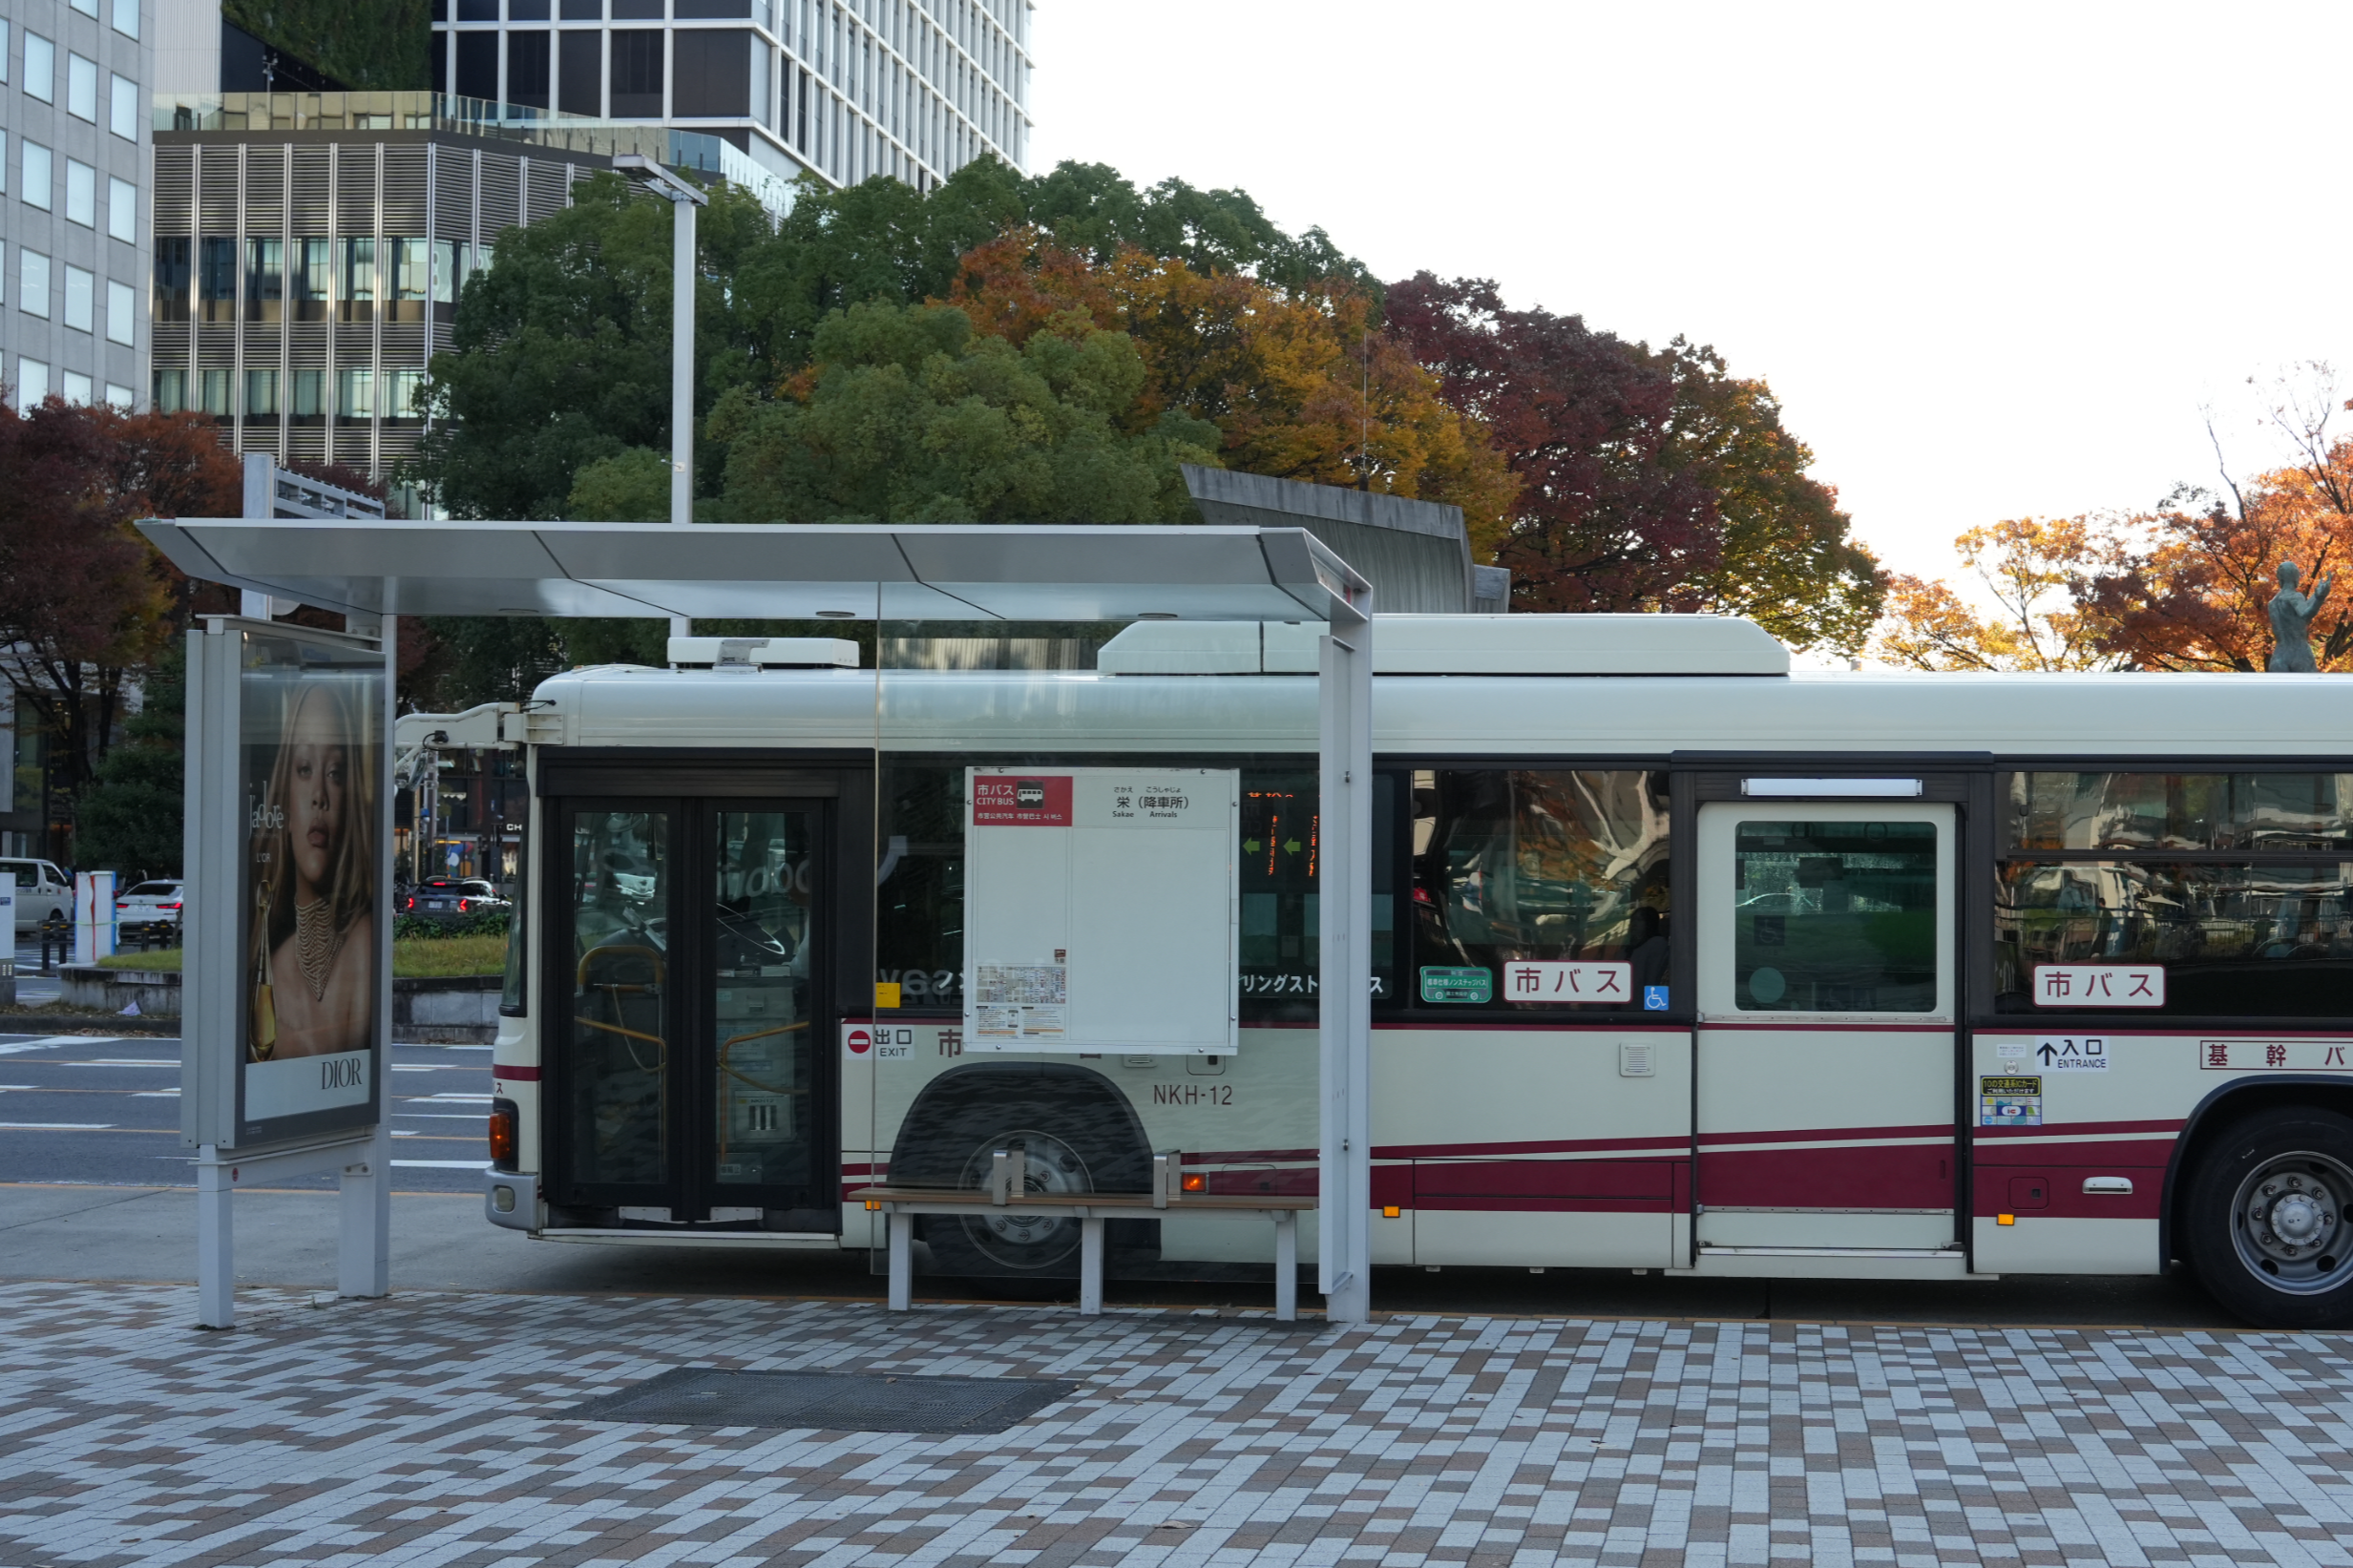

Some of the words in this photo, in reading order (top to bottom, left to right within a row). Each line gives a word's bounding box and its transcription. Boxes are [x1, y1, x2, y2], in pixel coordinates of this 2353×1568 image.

[977, 784, 1014, 796] 市バス
[1515, 967, 1621, 993] 市バス
[2045, 972, 2153, 997] 市バス
[874, 1028, 912, 1045] 出口
[880, 1047, 907, 1057] EXIT
[2062, 1038, 2103, 1056] 入口
[2208, 1043, 2346, 1067] 基幹バ
[2058, 1058, 2107, 1069] ENTRANCE
[321, 1057, 363, 1090] DIOR
[1154, 1084, 1232, 1105] NKH-12
